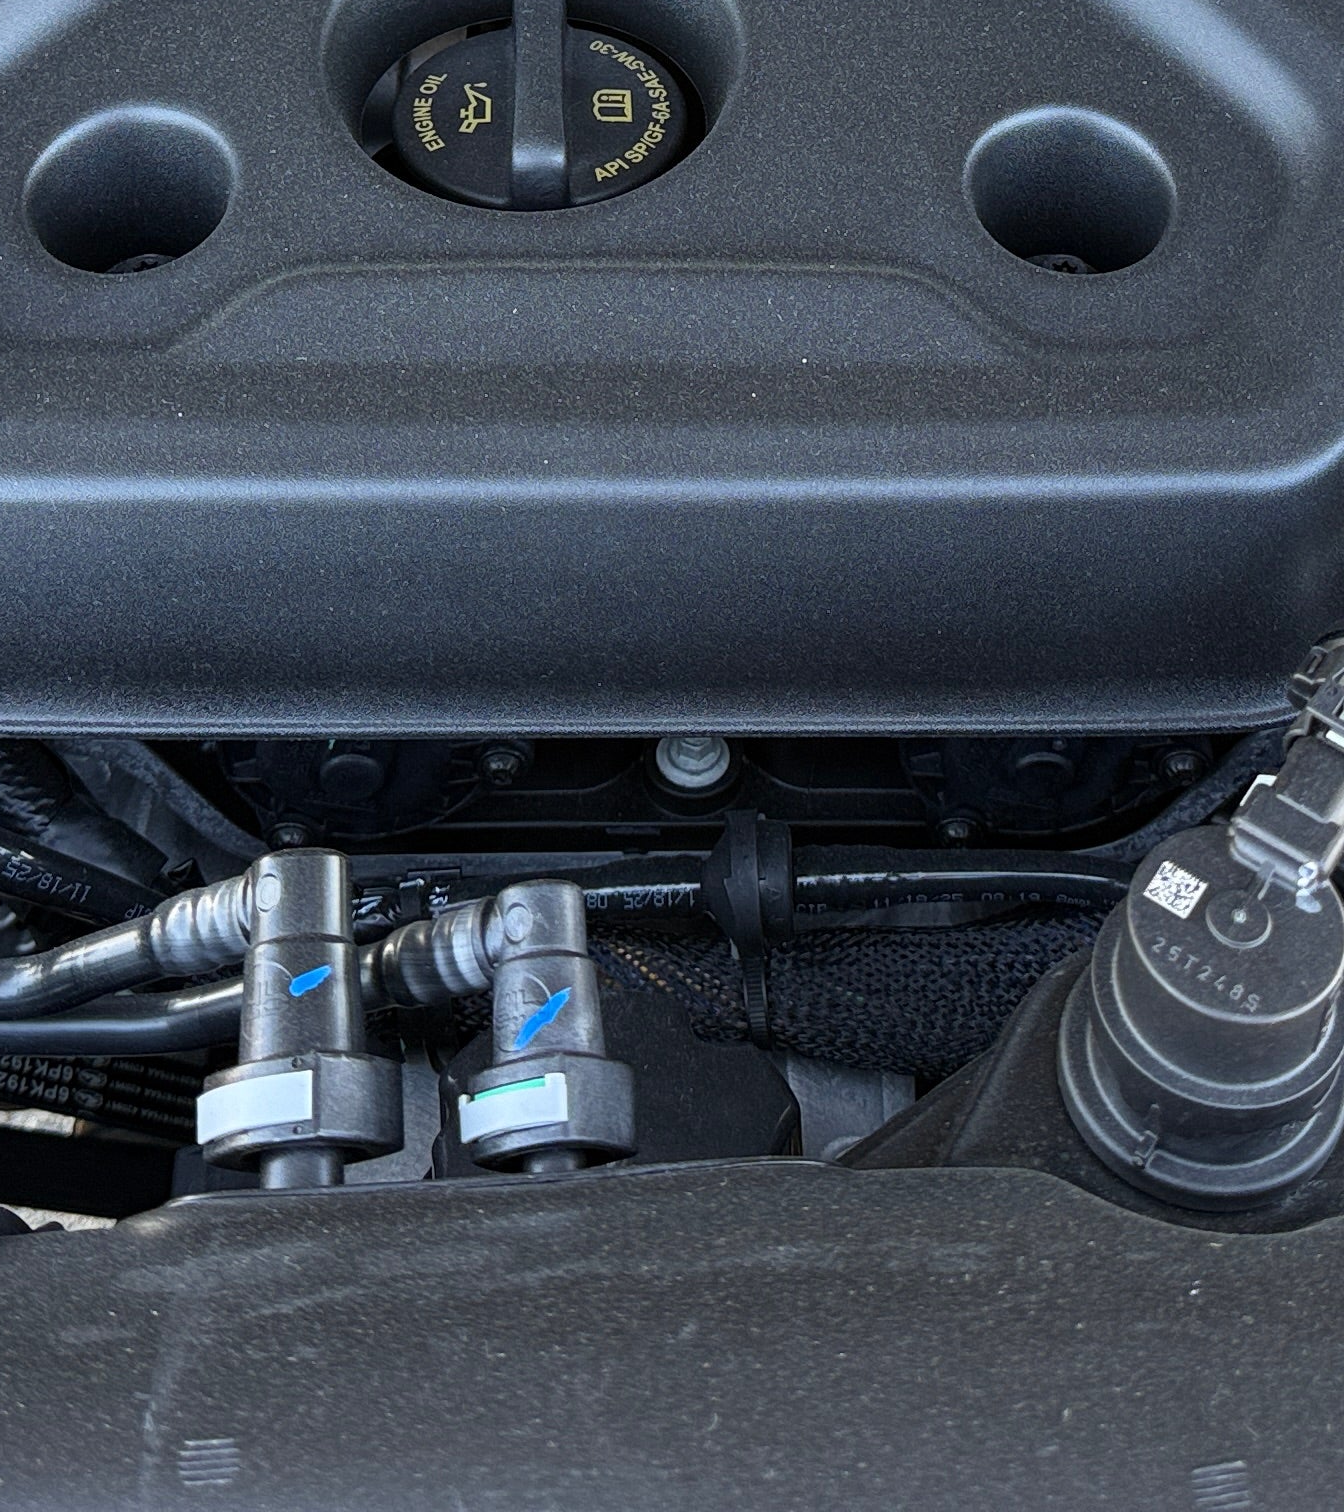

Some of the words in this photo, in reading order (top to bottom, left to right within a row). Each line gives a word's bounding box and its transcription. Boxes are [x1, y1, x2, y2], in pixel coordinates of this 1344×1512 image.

[419, 71, 448, 95] OIL
[413, 97, 445, 152] ENGINE
[594, 159, 628, 182] API
